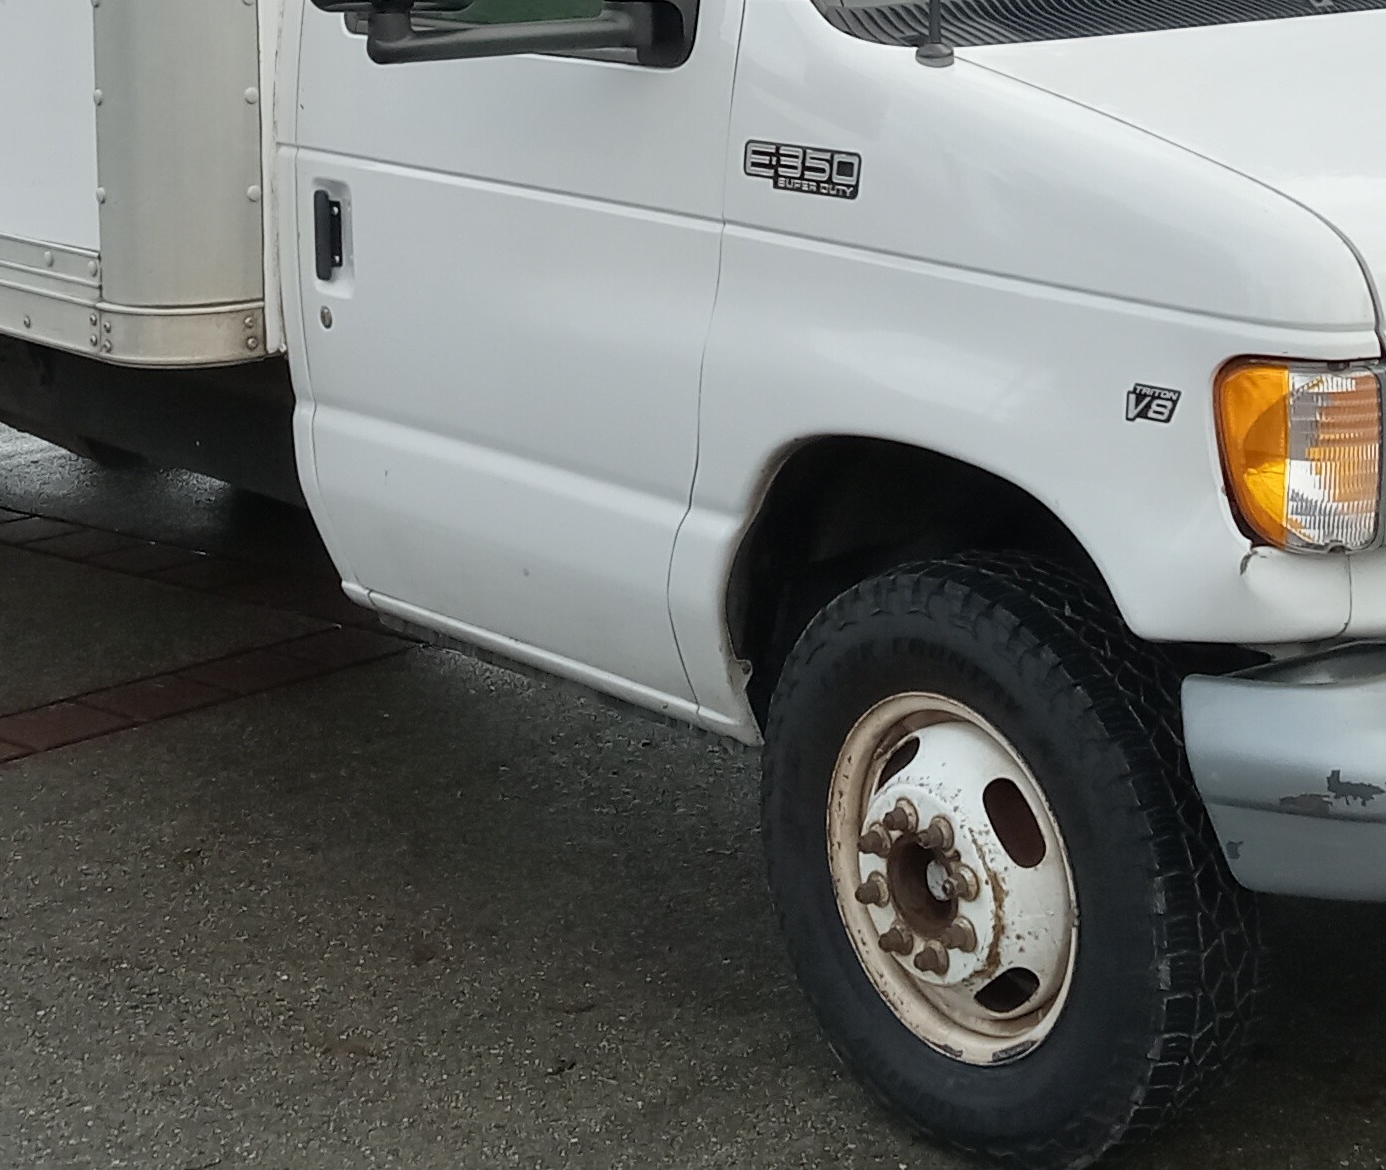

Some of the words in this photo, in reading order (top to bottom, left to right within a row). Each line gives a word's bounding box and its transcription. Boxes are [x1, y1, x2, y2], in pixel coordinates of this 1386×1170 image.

[777, 177, 817, 192] SUPER
[819, 182, 854, 197] DUTY
[1135, 386, 1178, 400] TRITON
[1127, 393, 1173, 420] V8
